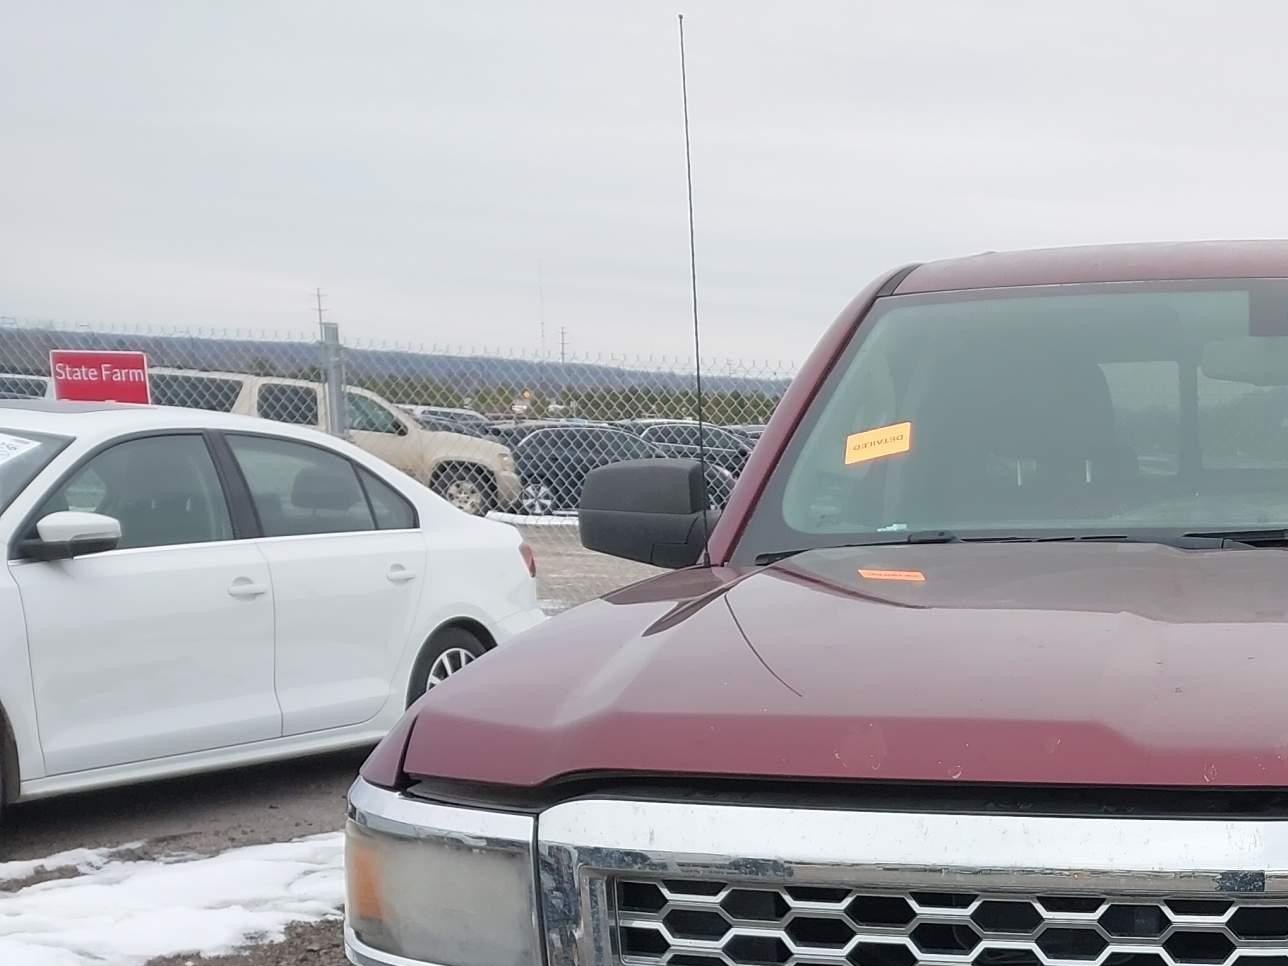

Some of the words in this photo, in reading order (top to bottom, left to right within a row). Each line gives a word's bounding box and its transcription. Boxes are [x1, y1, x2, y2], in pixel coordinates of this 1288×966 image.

[55, 363, 98, 380] State
[101, 364, 144, 381] Farm
[853, 434, 904, 451] DETAILED
